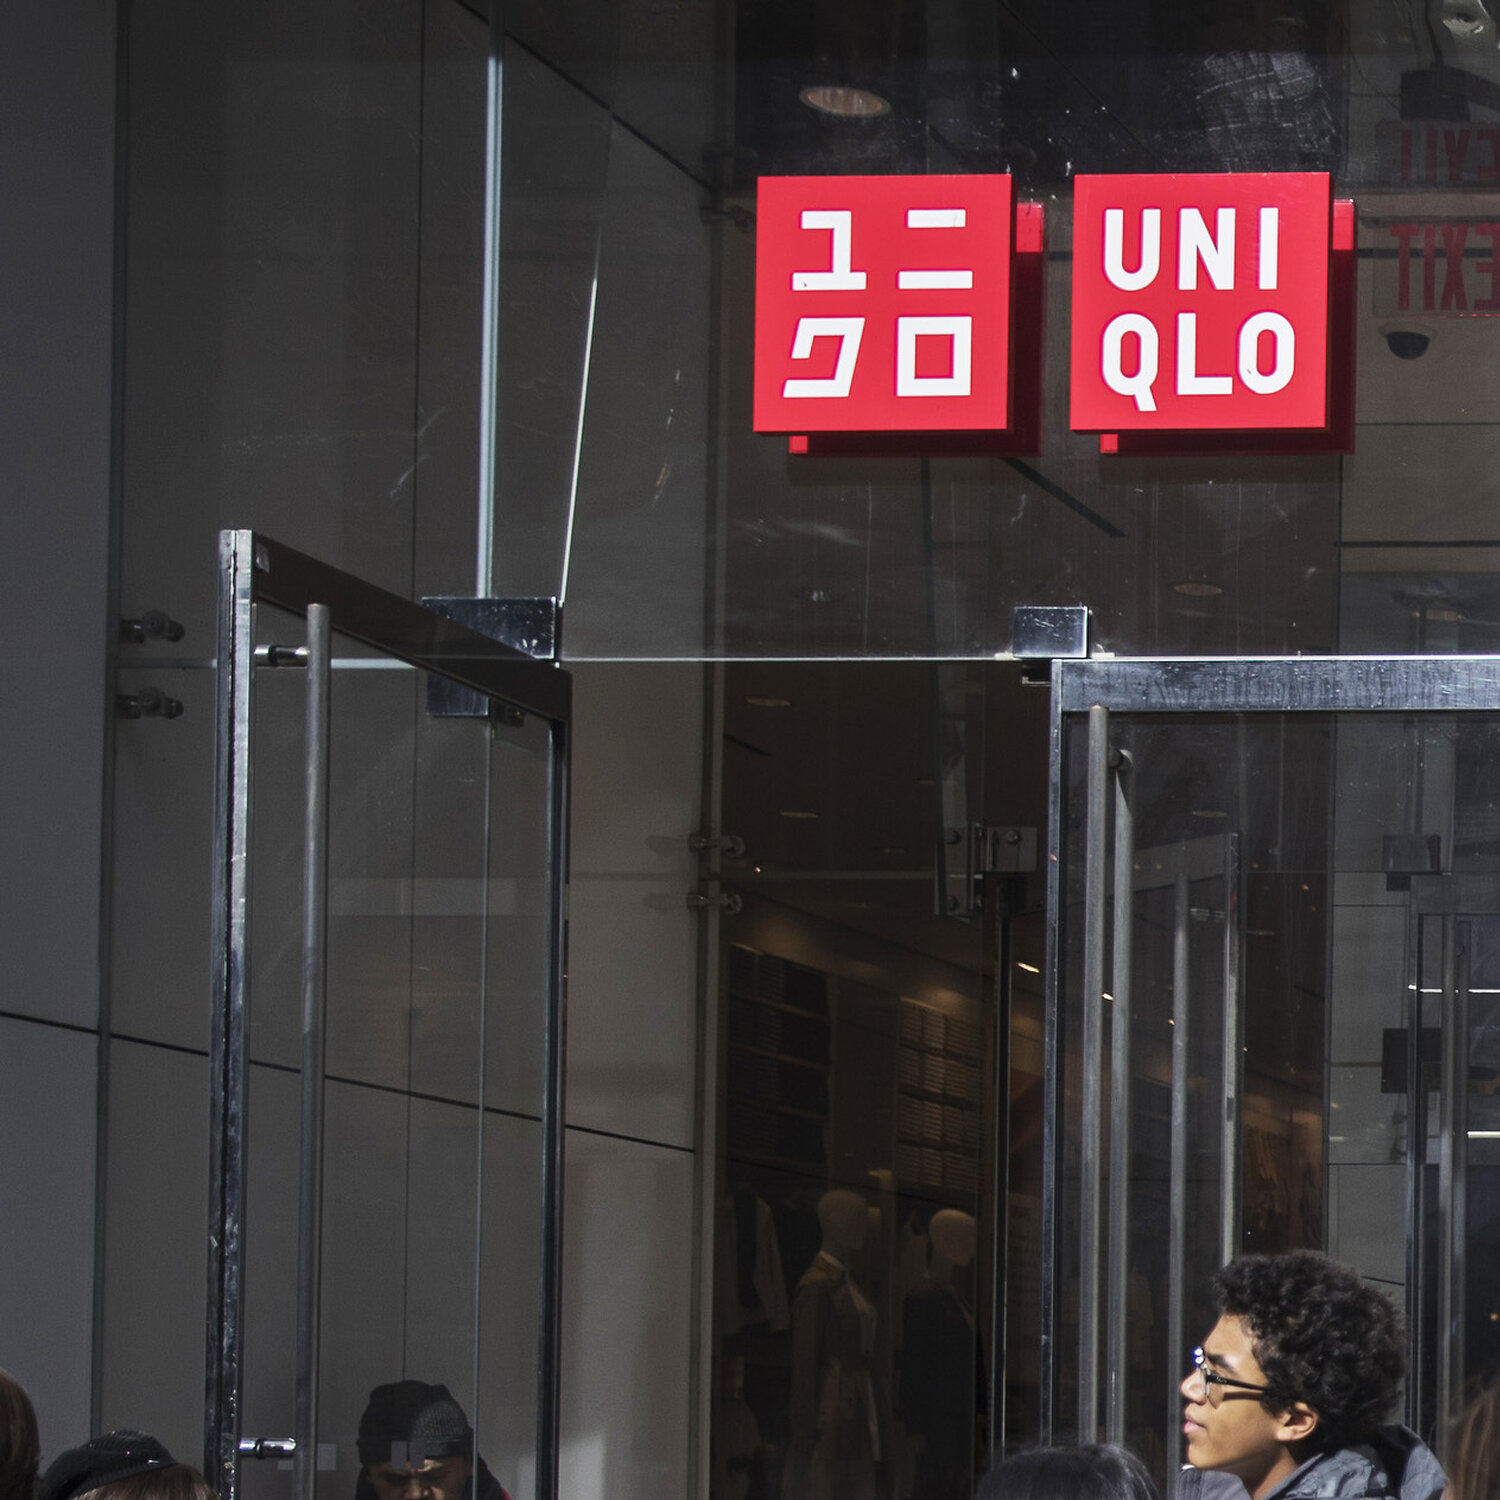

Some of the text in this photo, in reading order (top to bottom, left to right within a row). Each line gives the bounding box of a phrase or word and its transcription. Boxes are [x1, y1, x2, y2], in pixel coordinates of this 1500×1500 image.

[792, 209, 973, 290] ユニ
[1104, 207, 1278, 291] UNI
[783, 316, 972, 398] クロ
[1102, 312, 1295, 412] QLO
